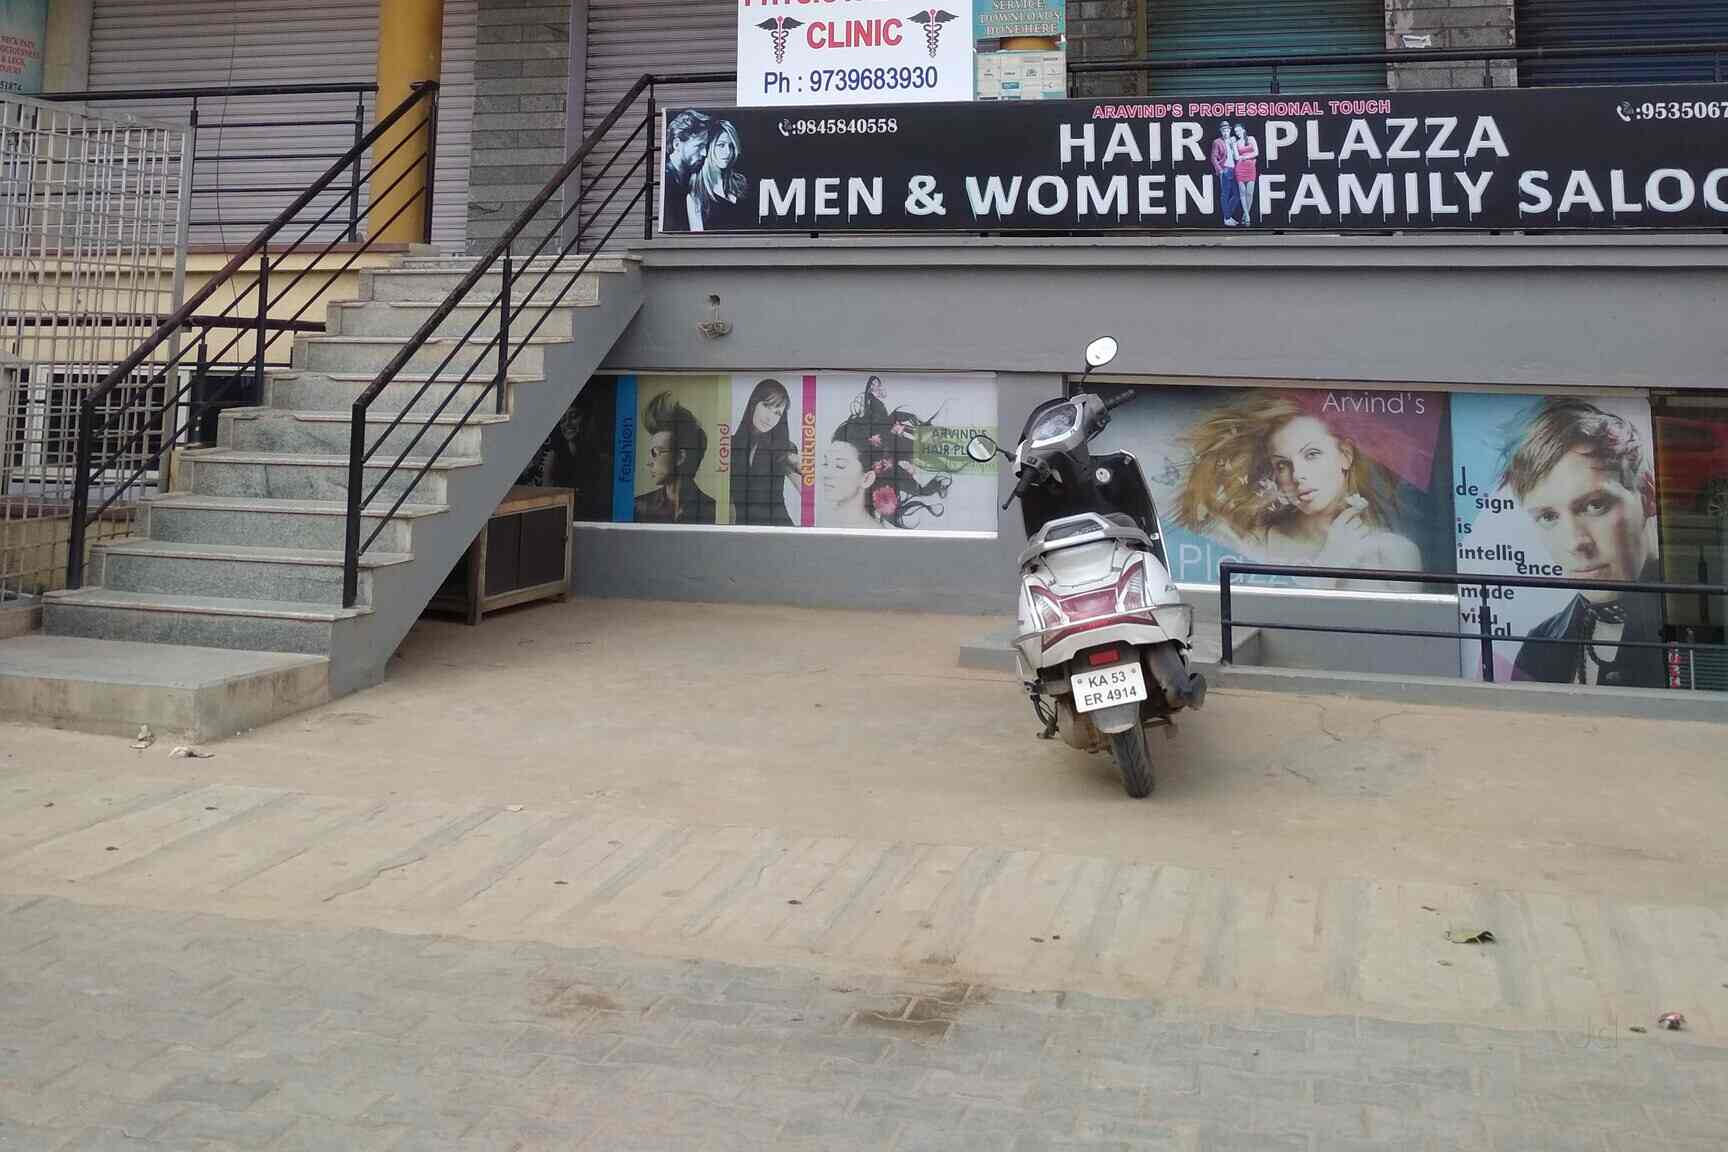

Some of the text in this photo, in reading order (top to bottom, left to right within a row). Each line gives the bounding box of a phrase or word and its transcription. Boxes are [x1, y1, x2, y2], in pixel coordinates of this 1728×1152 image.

[806, 18, 904, 49] CLINIC
[764, 70, 791, 94] Ph
[809, 66, 938, 92] 9739683930
[1092, 100, 1391, 119] ARAVIND'S PROFESSIONAL TOUCH
[1060, 116, 1510, 167] HAIR PLAZZA
[758, 176, 884, 221] MEN
[904, 175, 947, 216] &
[965, 173, 1215, 221] WOMEN
[1258, 170, 1494, 221] FAMILY
[1322, 391, 1426, 416] Arvind's
[619, 416, 633, 482] fashion
[716, 423, 730, 473] trend
[801, 412, 816, 487] attitude
[1456, 466, 1478, 497] de
[1475, 493, 1515, 514] sign
[1457, 517, 1472, 534] is
[1458, 542, 1526, 568] intellig
[1517, 563, 1563, 576] ence
[1461, 585, 1515, 600] made
[1088, 671, 1127, 689] KA 53
[1084, 686, 1137, 706] ER 4914
